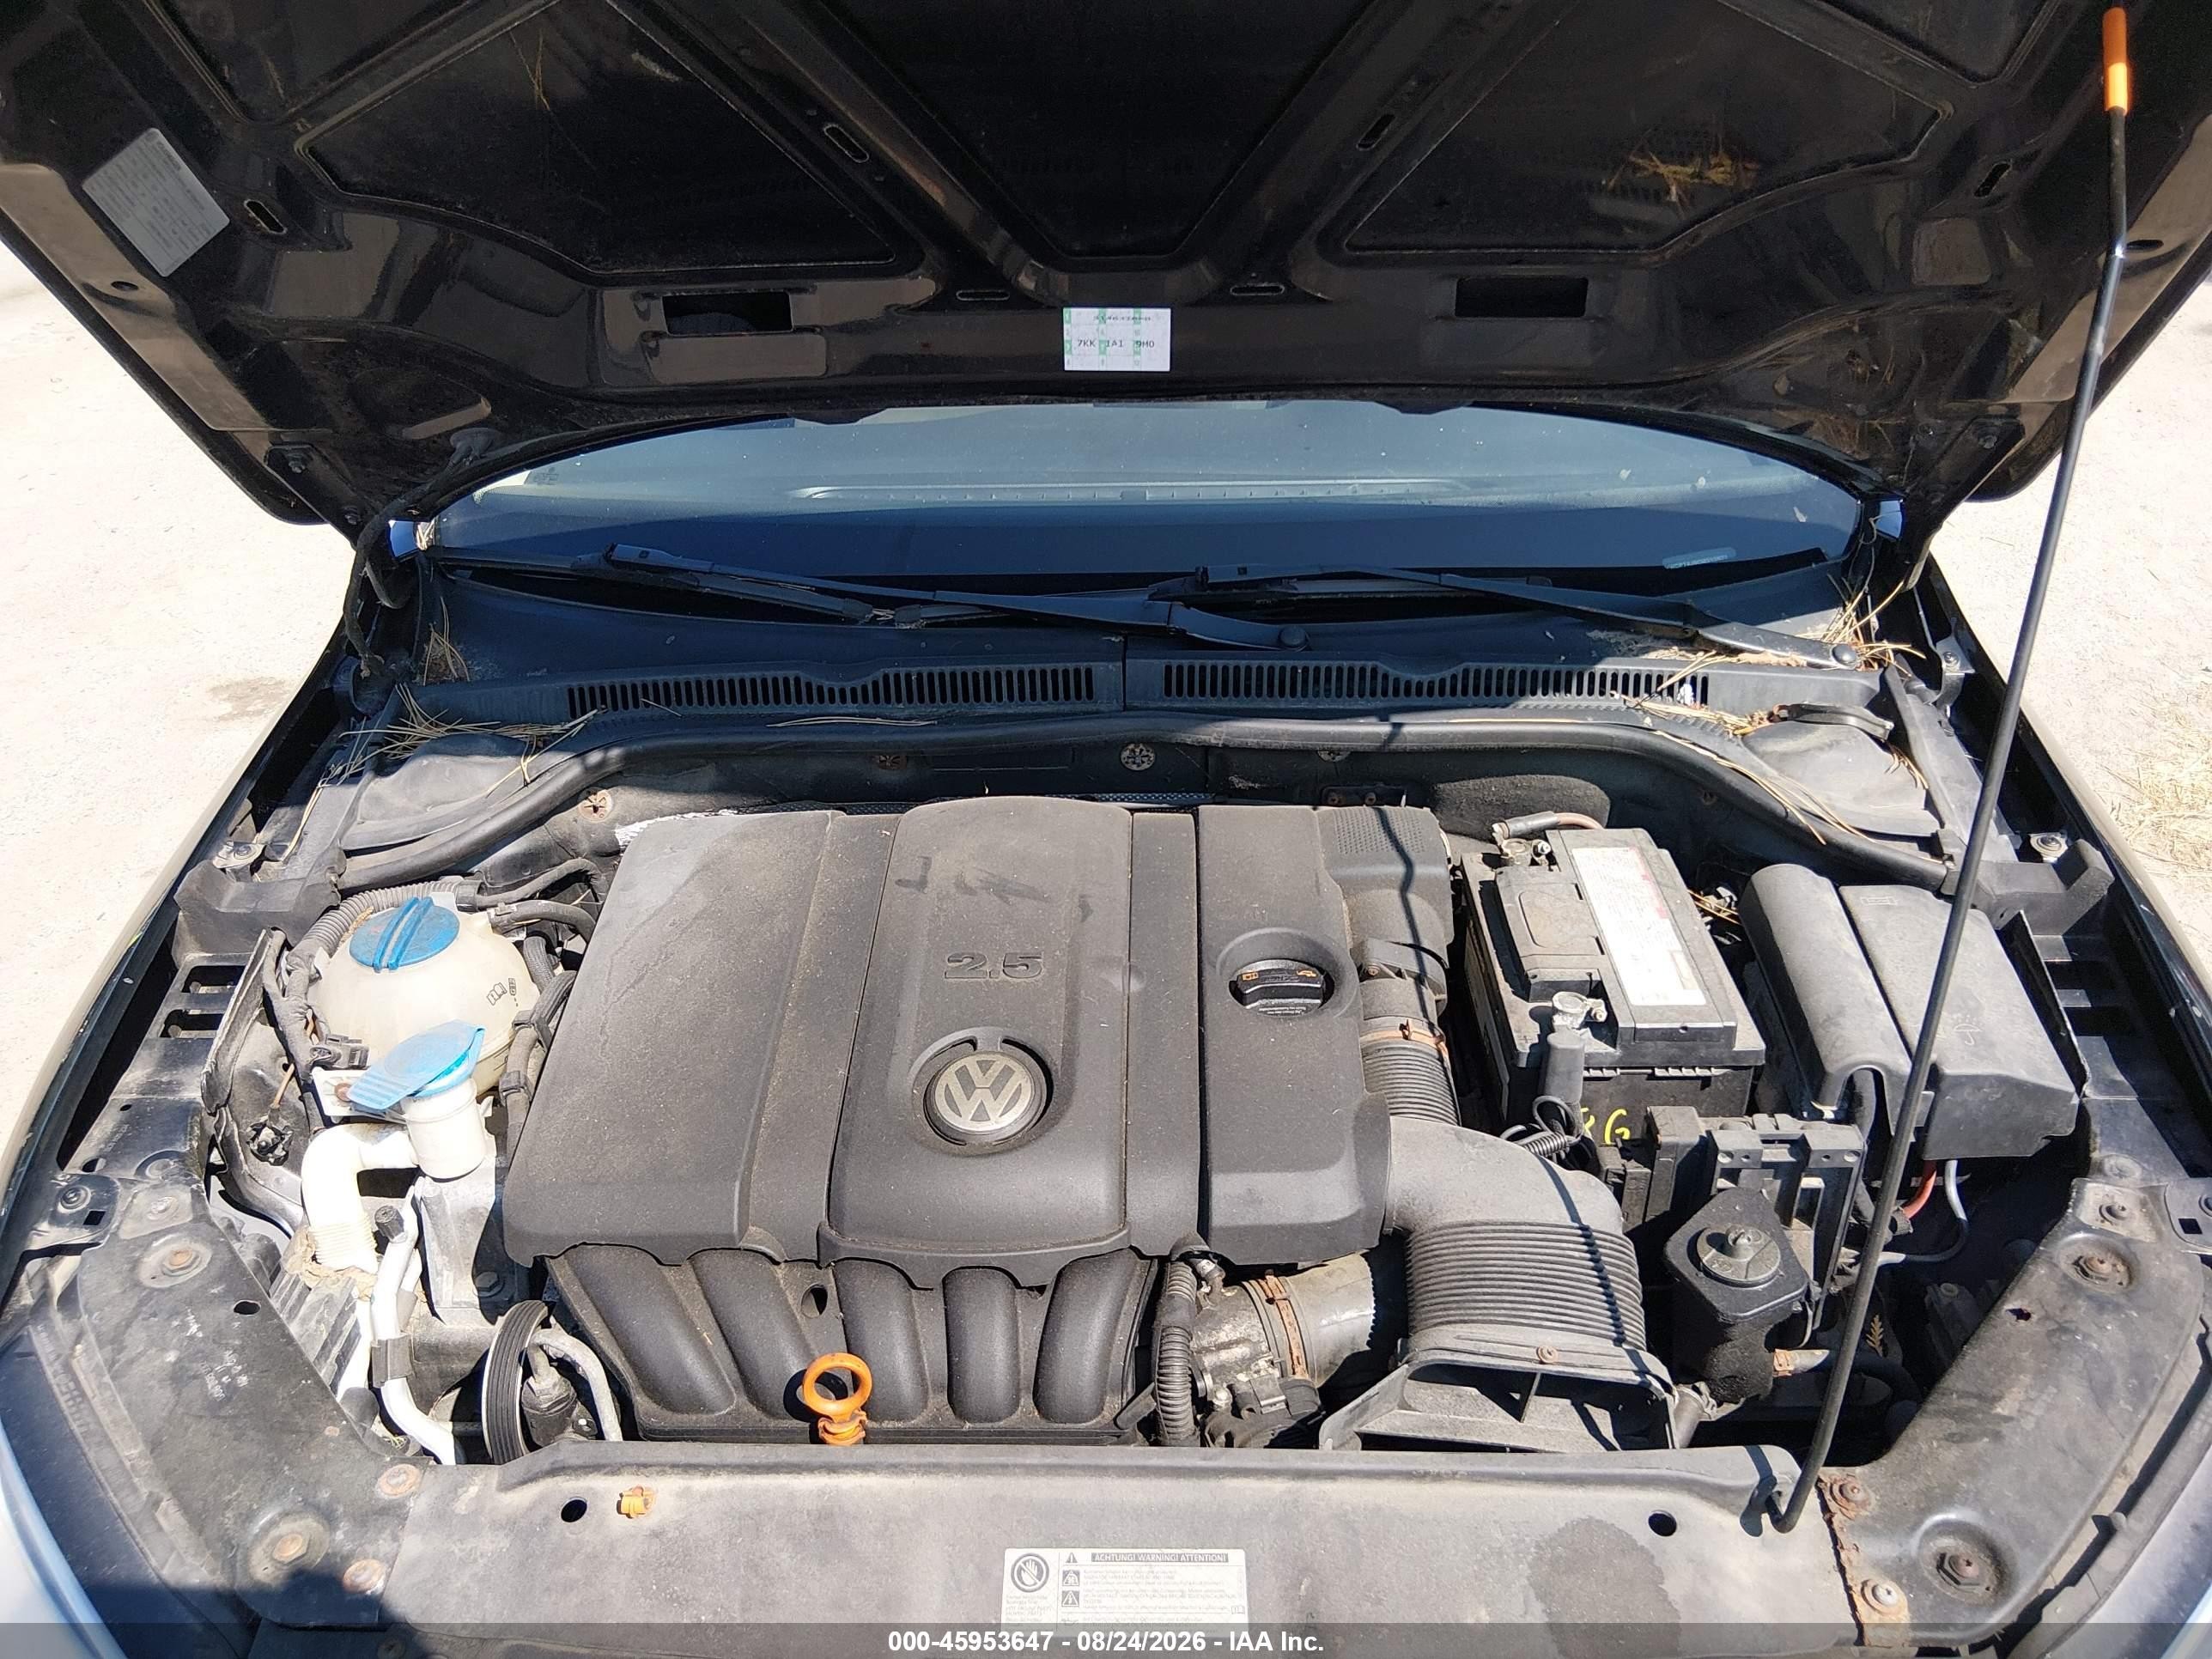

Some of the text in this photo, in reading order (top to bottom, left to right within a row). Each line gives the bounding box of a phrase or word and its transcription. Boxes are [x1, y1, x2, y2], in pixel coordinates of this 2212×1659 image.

[1077, 339, 1097, 348] 7KK
[944, 951, 1043, 980] 2.5
[1094, 1553, 1226, 1563] ACHTUNG! WARNING! ATTENTION!
